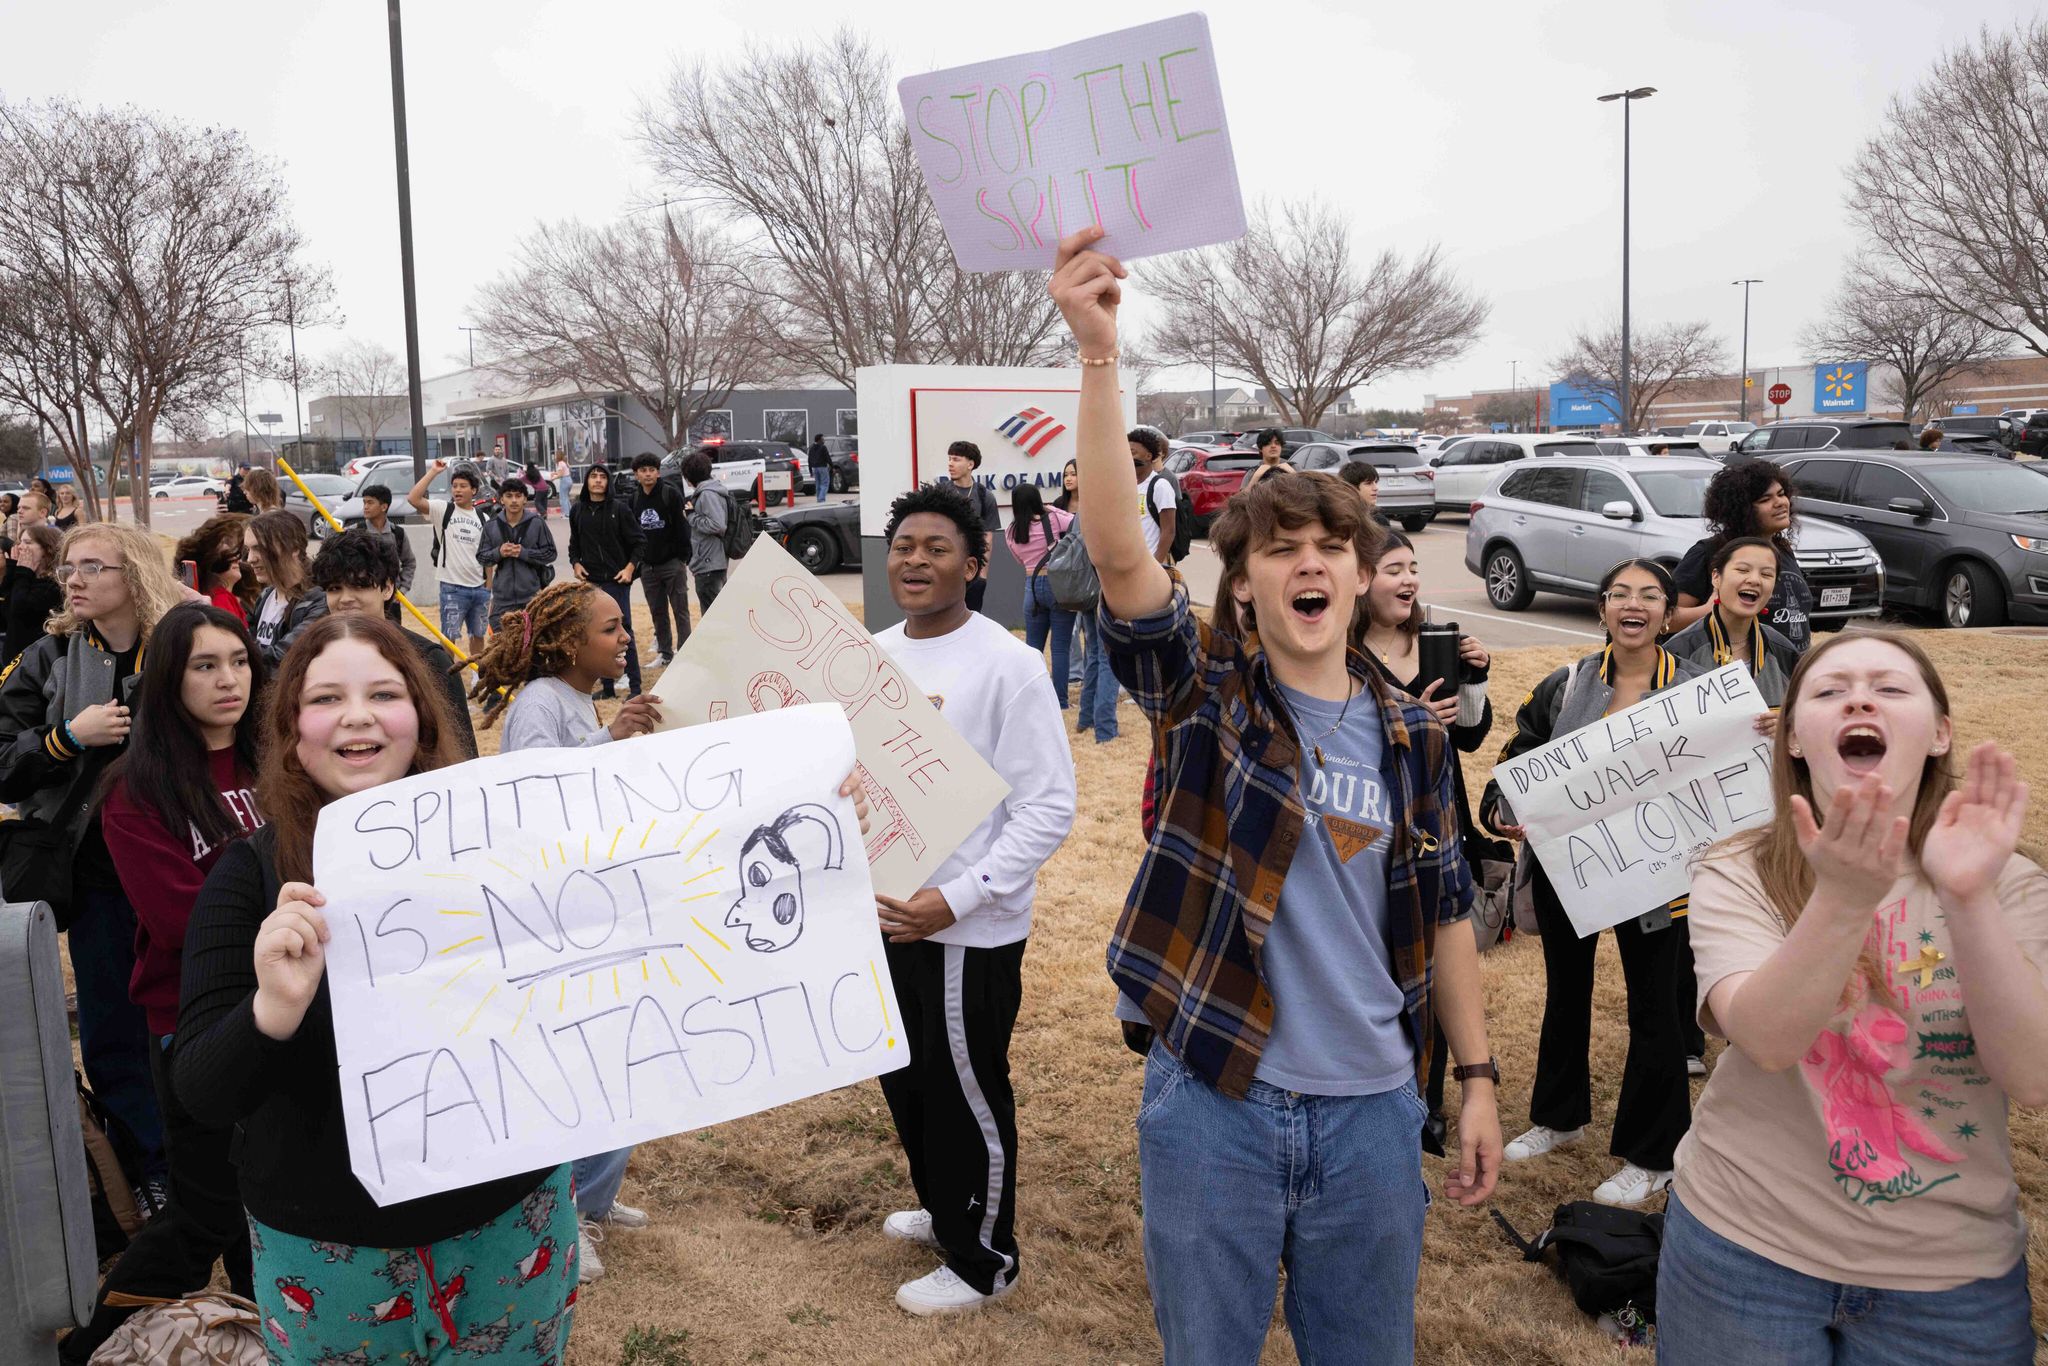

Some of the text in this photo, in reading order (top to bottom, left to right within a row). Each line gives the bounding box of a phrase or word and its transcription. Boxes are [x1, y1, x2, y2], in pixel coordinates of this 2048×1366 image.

[917, 47, 1221, 190] STOP THE
[976, 156, 1156, 252] SPLIT
[1570, 404, 1593, 412] Market
[1768, 389, 1792, 400] STOP
[1822, 398, 1855, 408] Walmart
[938, 471, 1062, 491] BNK OF AM
[1772, 607, 1808, 624] Destin
[748, 575, 910, 722] STOP
[881, 719, 951, 797] THE
[1306, 746, 1360, 768] Dtination
[1509, 667, 1751, 795] DON'T LET ME
[1564, 735, 1706, 811] WALK
[354, 740, 743, 870] SPLITTING
[353, 850, 682, 988] IS NOT
[1921, 1005, 1966, 1023] WITHOU
[361, 959, 897, 1186] FANTASTIC!
[1828, 1127, 1878, 1172] Let's
[1833, 1166, 1922, 1202] Dance
